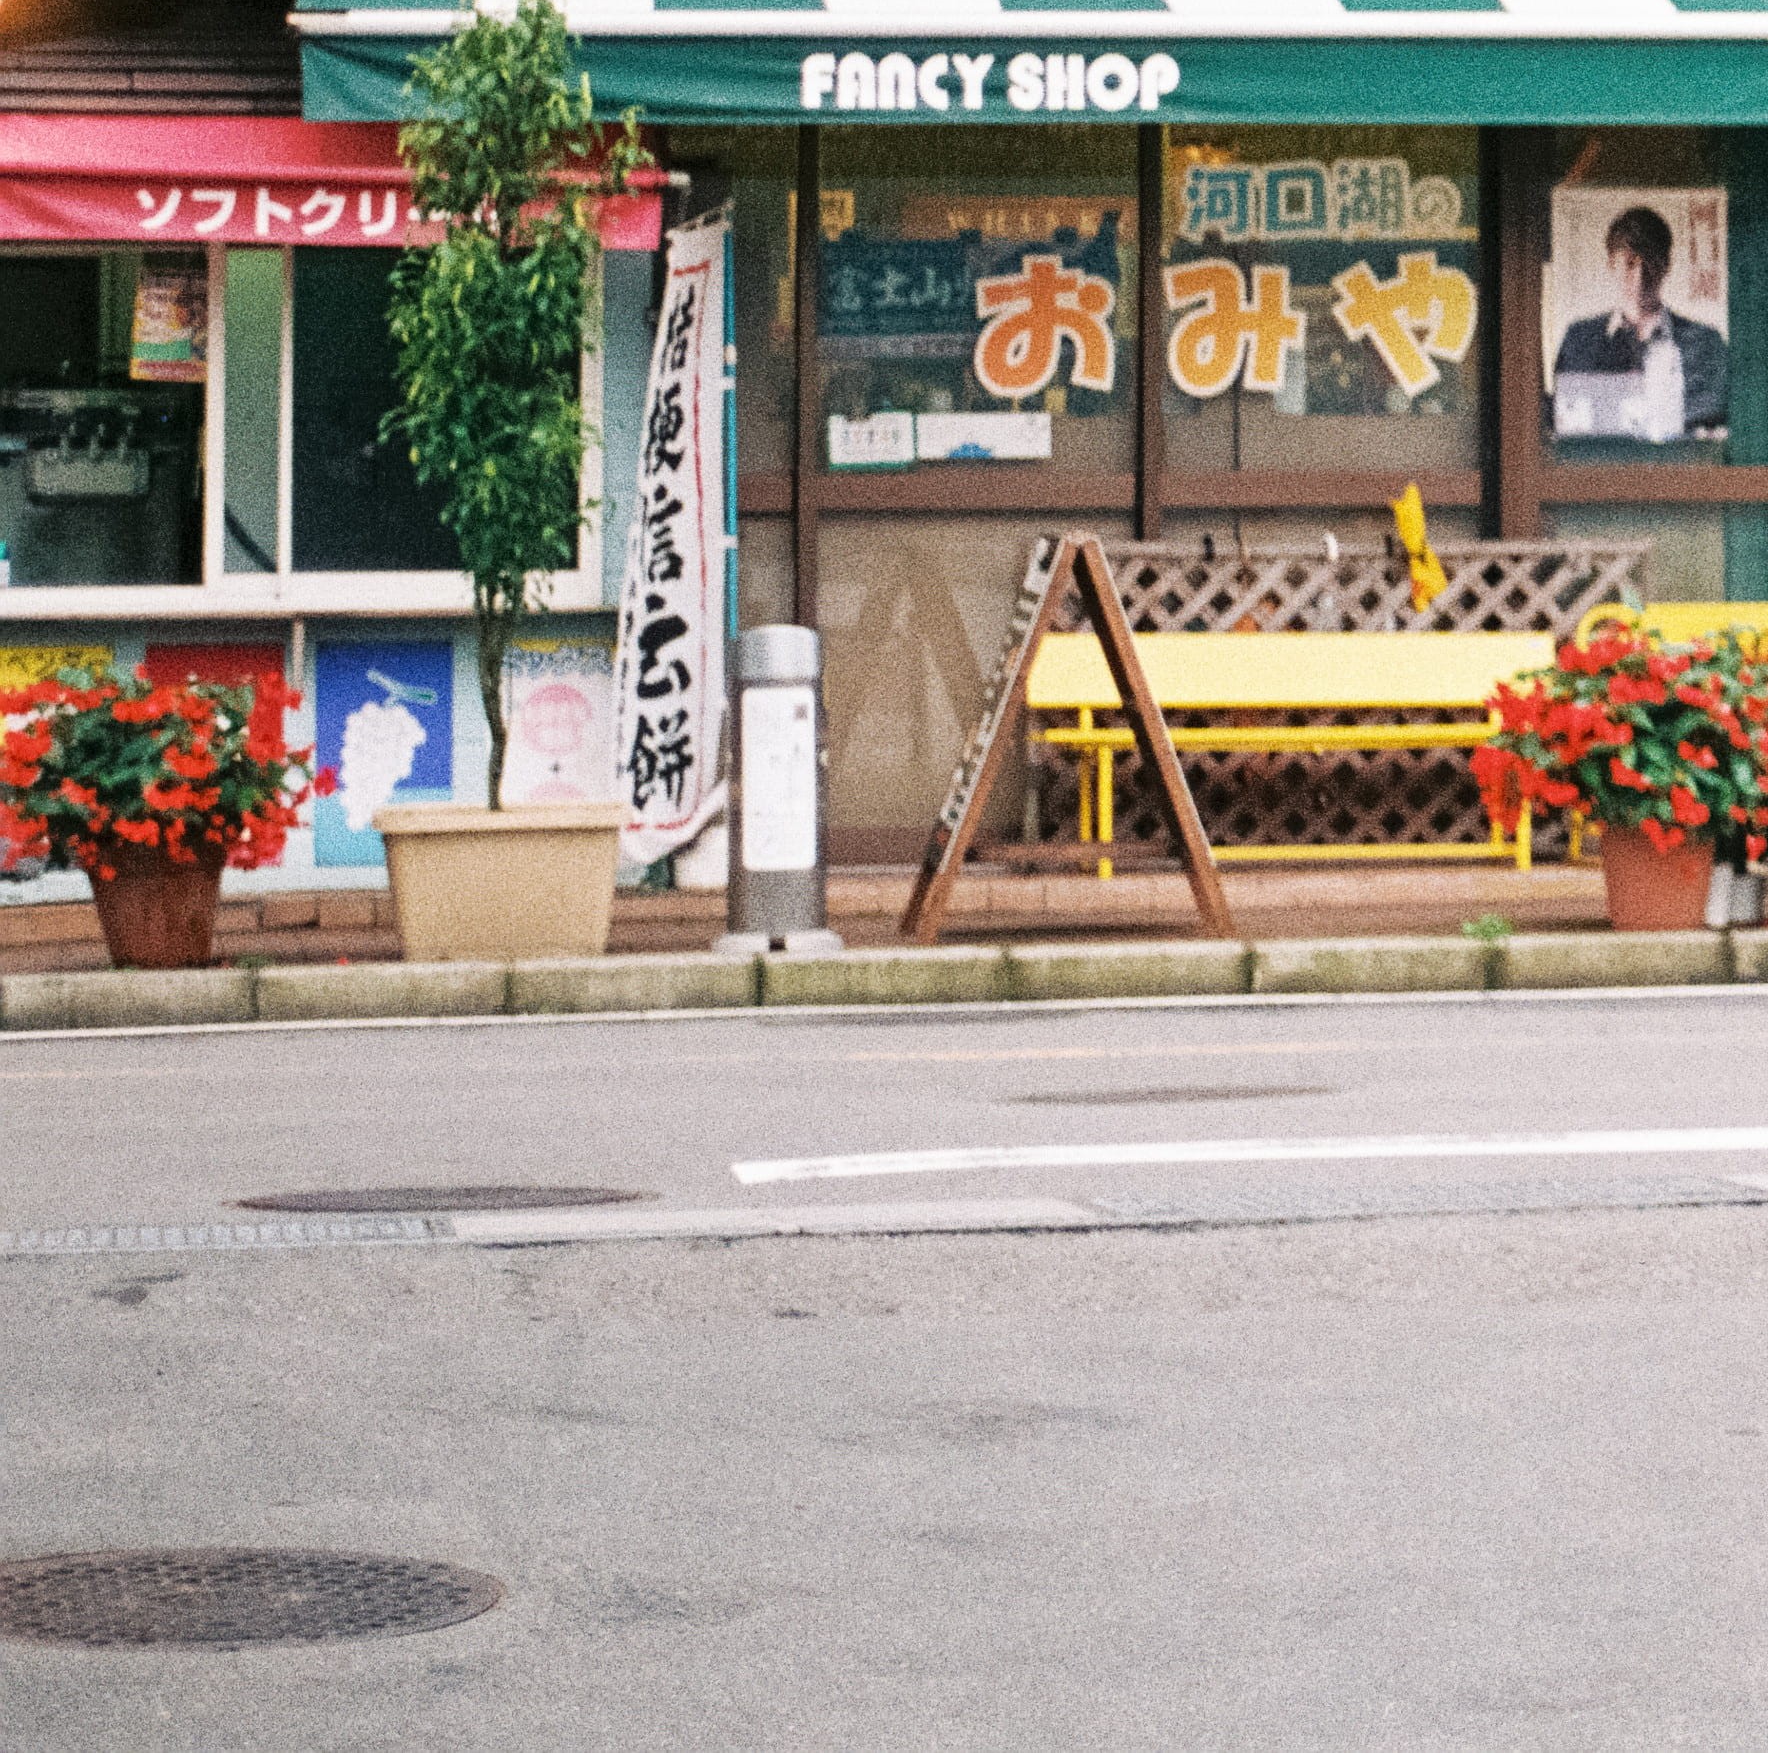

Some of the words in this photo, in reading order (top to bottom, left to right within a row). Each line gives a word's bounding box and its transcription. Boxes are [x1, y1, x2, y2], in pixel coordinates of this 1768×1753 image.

[801, 52, 995, 111] FANCY
[1006, 52, 1181, 112] SHOP
[1179, 158, 1463, 242] 河口湖の
[975, 250, 1478, 399] おみや
